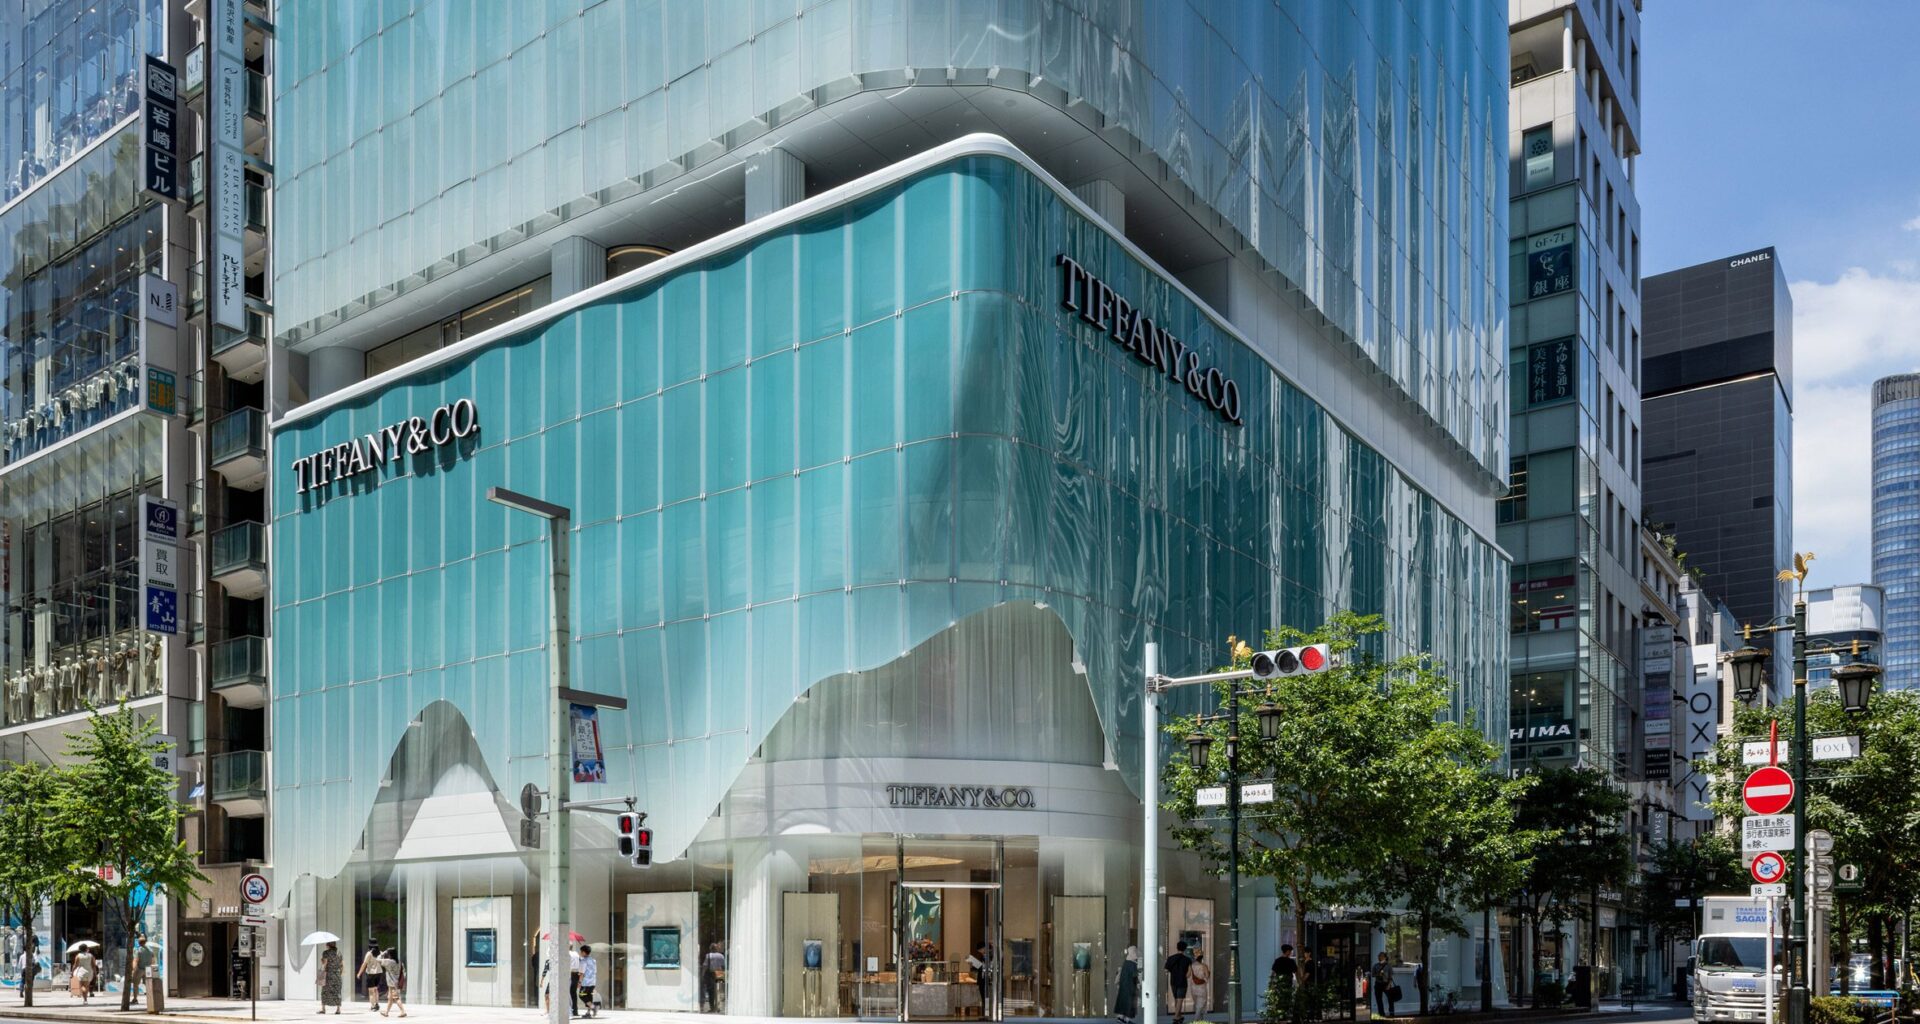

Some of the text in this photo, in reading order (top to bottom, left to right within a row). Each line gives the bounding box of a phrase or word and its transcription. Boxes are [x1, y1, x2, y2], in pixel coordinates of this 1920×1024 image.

[152, 106, 171, 193] 岩崎ビル
[1730, 252, 1771, 268] CHANEL
[1532, 274, 1570, 297] 銀座
[1056, 254, 1245, 427] TIFFANY&CO.
[1533, 347, 1547, 403] 美容外科
[1556, 342, 1568, 397] みゆき通り
[291, 398, 481, 495] TIFFANY&CO.
[155, 547, 169, 576] 買取
[149, 595, 175, 624] 青山
[1746, 748, 1786, 757] みゆきり
[1815, 742, 1857, 754] FOXEY
[886, 784, 1037, 809] TIFFANY&CO.
[1746, 817, 1791, 828] 自転車を除く
[1746, 828, 1791, 839] 歩行者天国実施中
[1746, 839, 1768, 849] を除く
[1754, 887, 1762, 895] 18
[1776, 886, 1782, 894] 3
